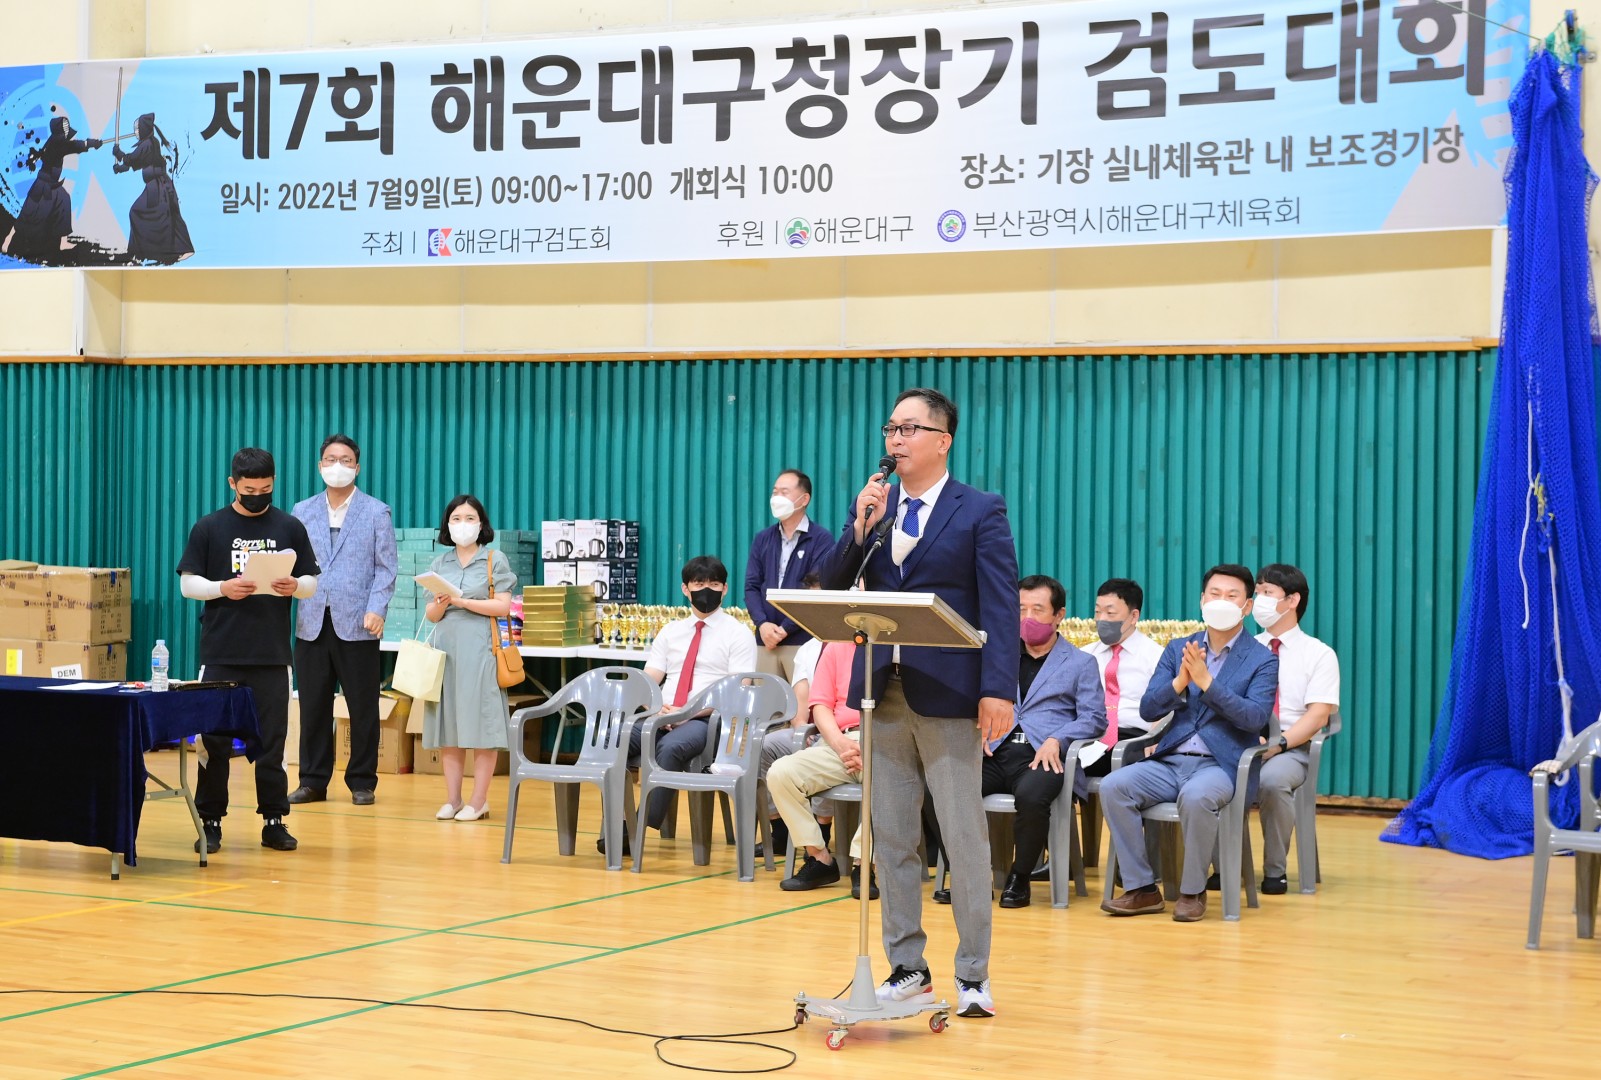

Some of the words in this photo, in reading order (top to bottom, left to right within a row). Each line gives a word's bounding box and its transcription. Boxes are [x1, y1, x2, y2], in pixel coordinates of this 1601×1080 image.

[200, 61, 395, 160] 제7회
[430, 20, 1040, 152] 해운대구청장기
[1084, 0, 1487, 121] 검도대회
[960, 152, 1025, 189] 장소:
[1037, 148, 1094, 184] 기장
[1103, 140, 1254, 183] 실내체육관
[1265, 135, 1293, 173] 내
[1305, 124, 1464, 168] 보조경기장
[220, 181, 269, 214] 일시:
[278, 179, 357, 211] 2022년
[366, 175, 483, 210] 7월9일(토)
[491, 171, 653, 204] 09:00~17:00
[670, 164, 746, 200] 개회식
[758, 163, 833, 194] 10:00
[814, 215, 914, 244] 해운대구
[972, 197, 1301, 238] 부산광역시해운대구체육회
[361, 231, 403, 256] 주최
[454, 225, 611, 254] 해운대구검도회
[717, 220, 764, 247] 후원
[232, 537, 264, 550] Sorry
